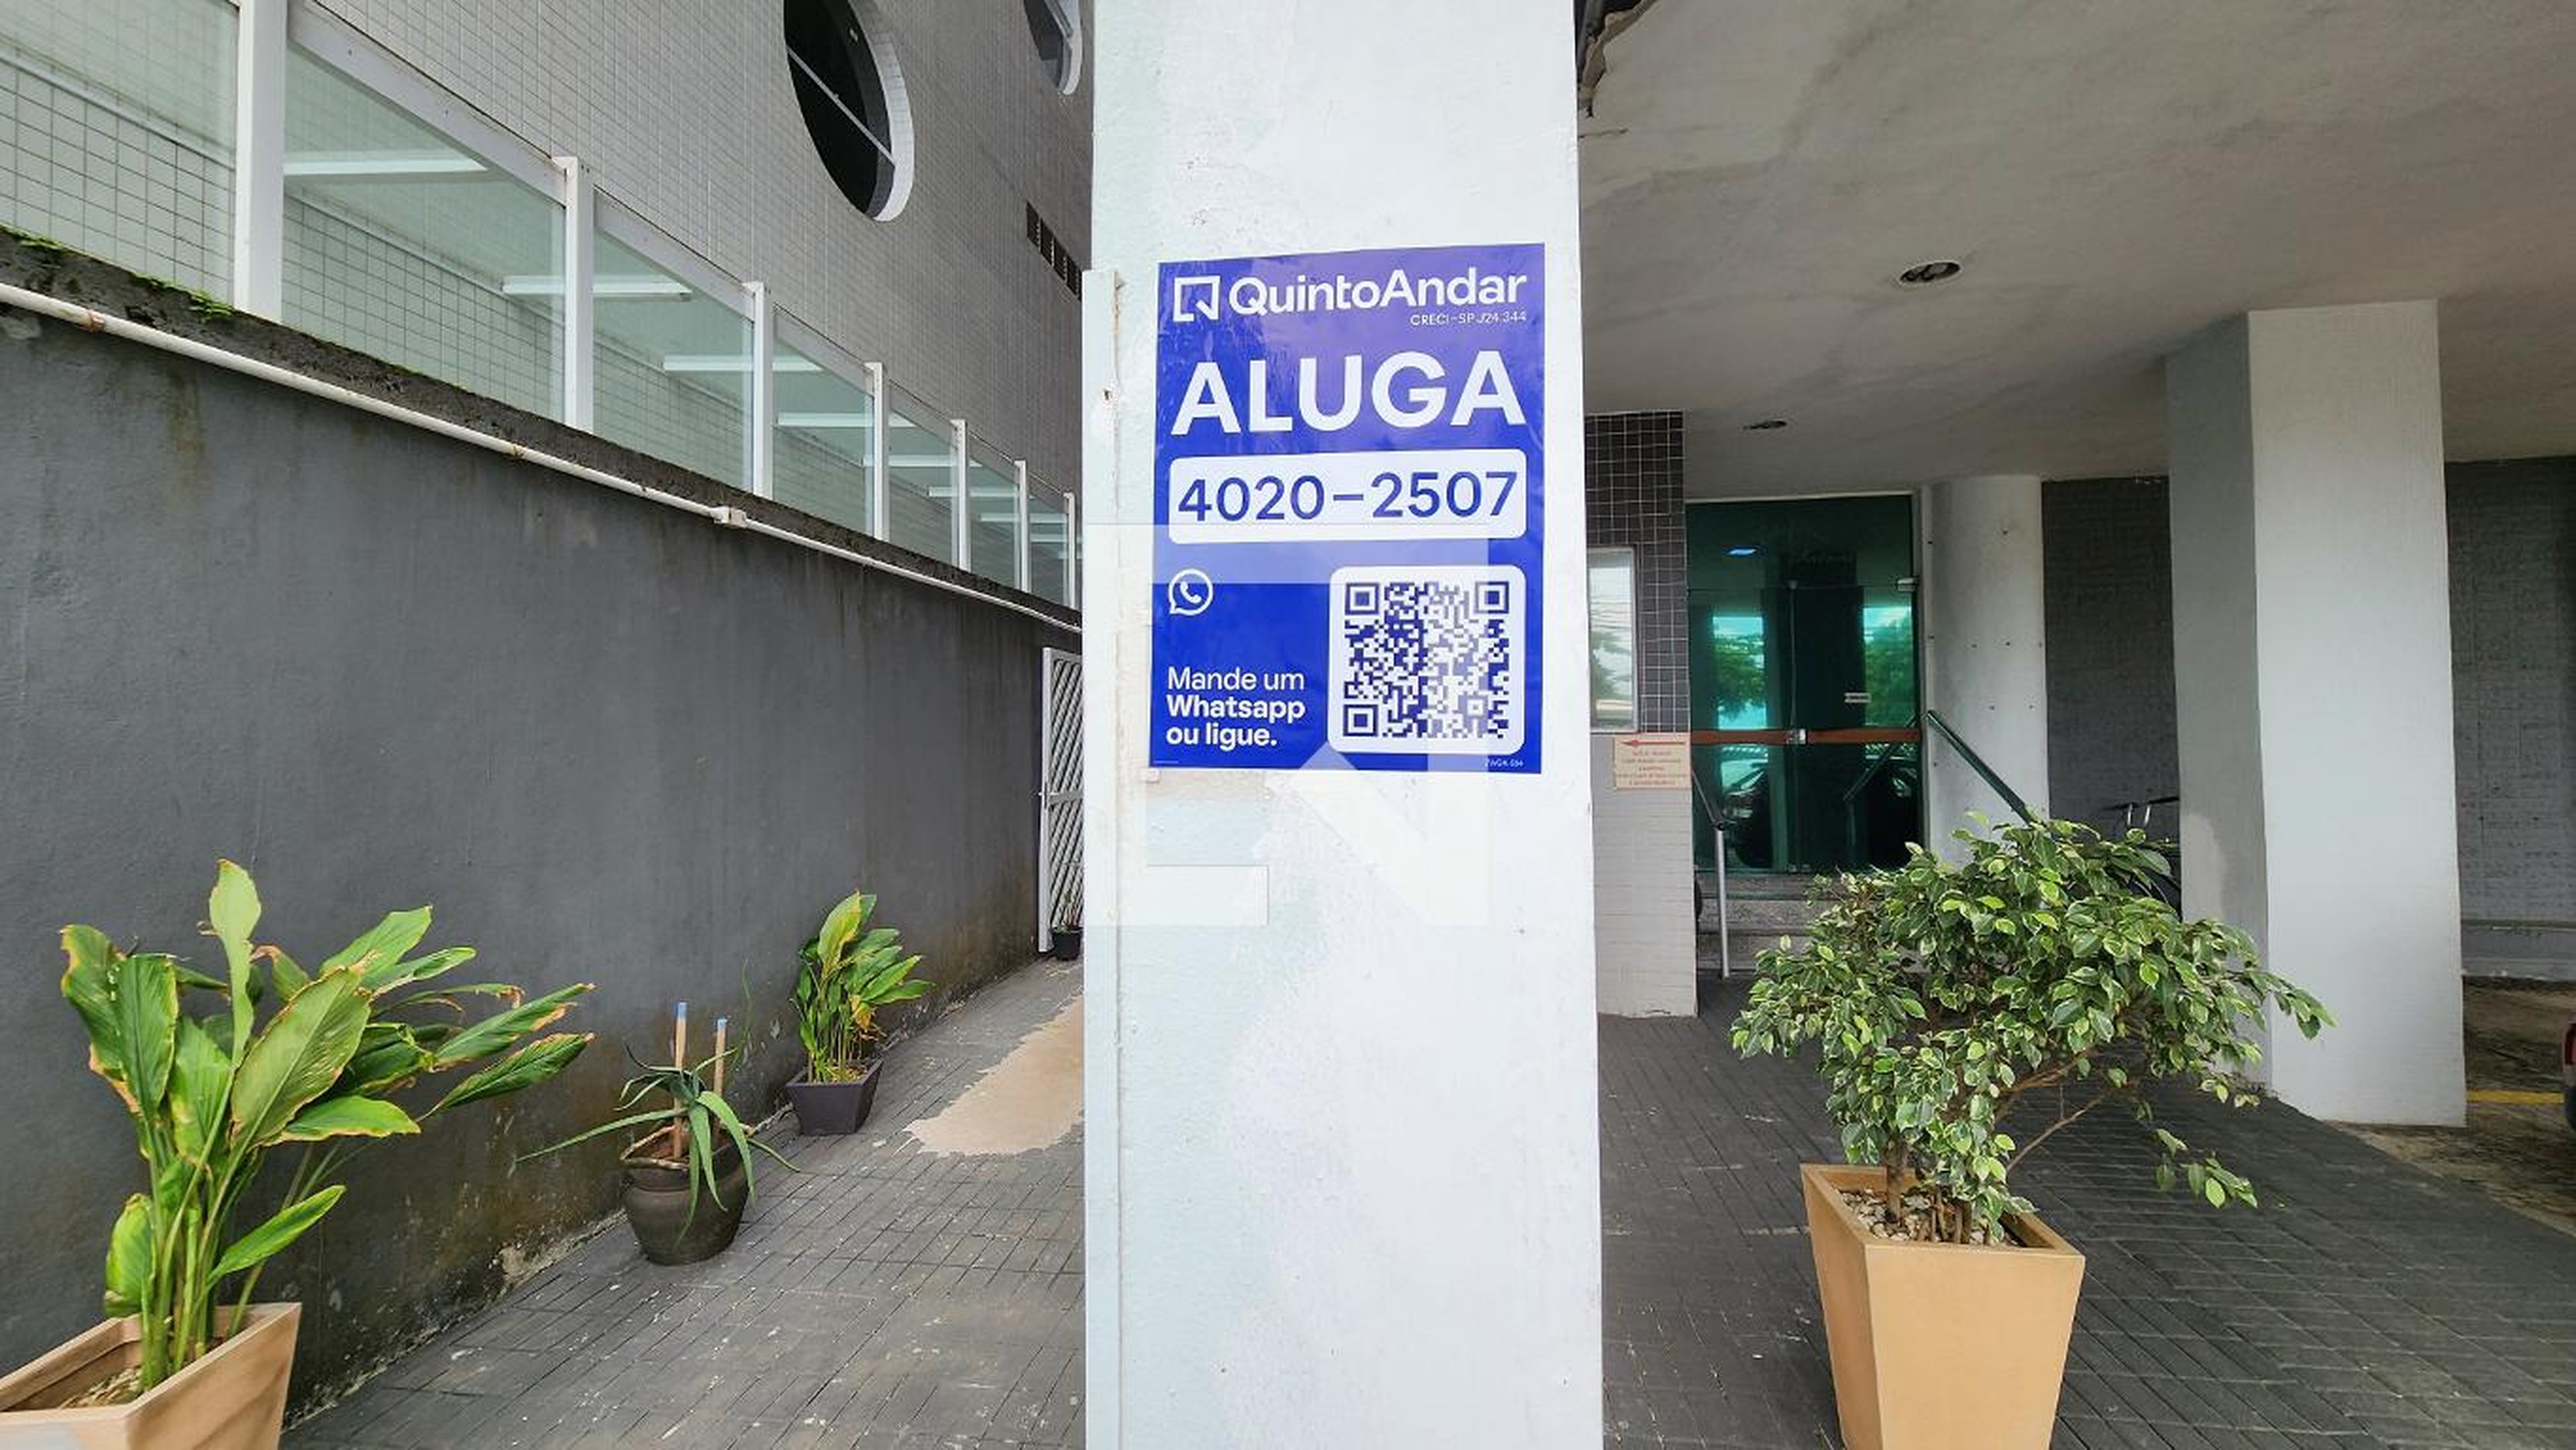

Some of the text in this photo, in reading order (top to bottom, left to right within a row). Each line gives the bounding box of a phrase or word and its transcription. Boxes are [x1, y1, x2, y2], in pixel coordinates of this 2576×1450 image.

[1229, 268, 1527, 315] QuintoAndar
[1171, 351, 1526, 436] ALUGA
[1178, 471, 1517, 522] 4020-2507
[1168, 667, 1305, 691] Mande um
[1167, 695, 1305, 724] Whatsapp
[1167, 722, 1277, 751] ou ligue.
